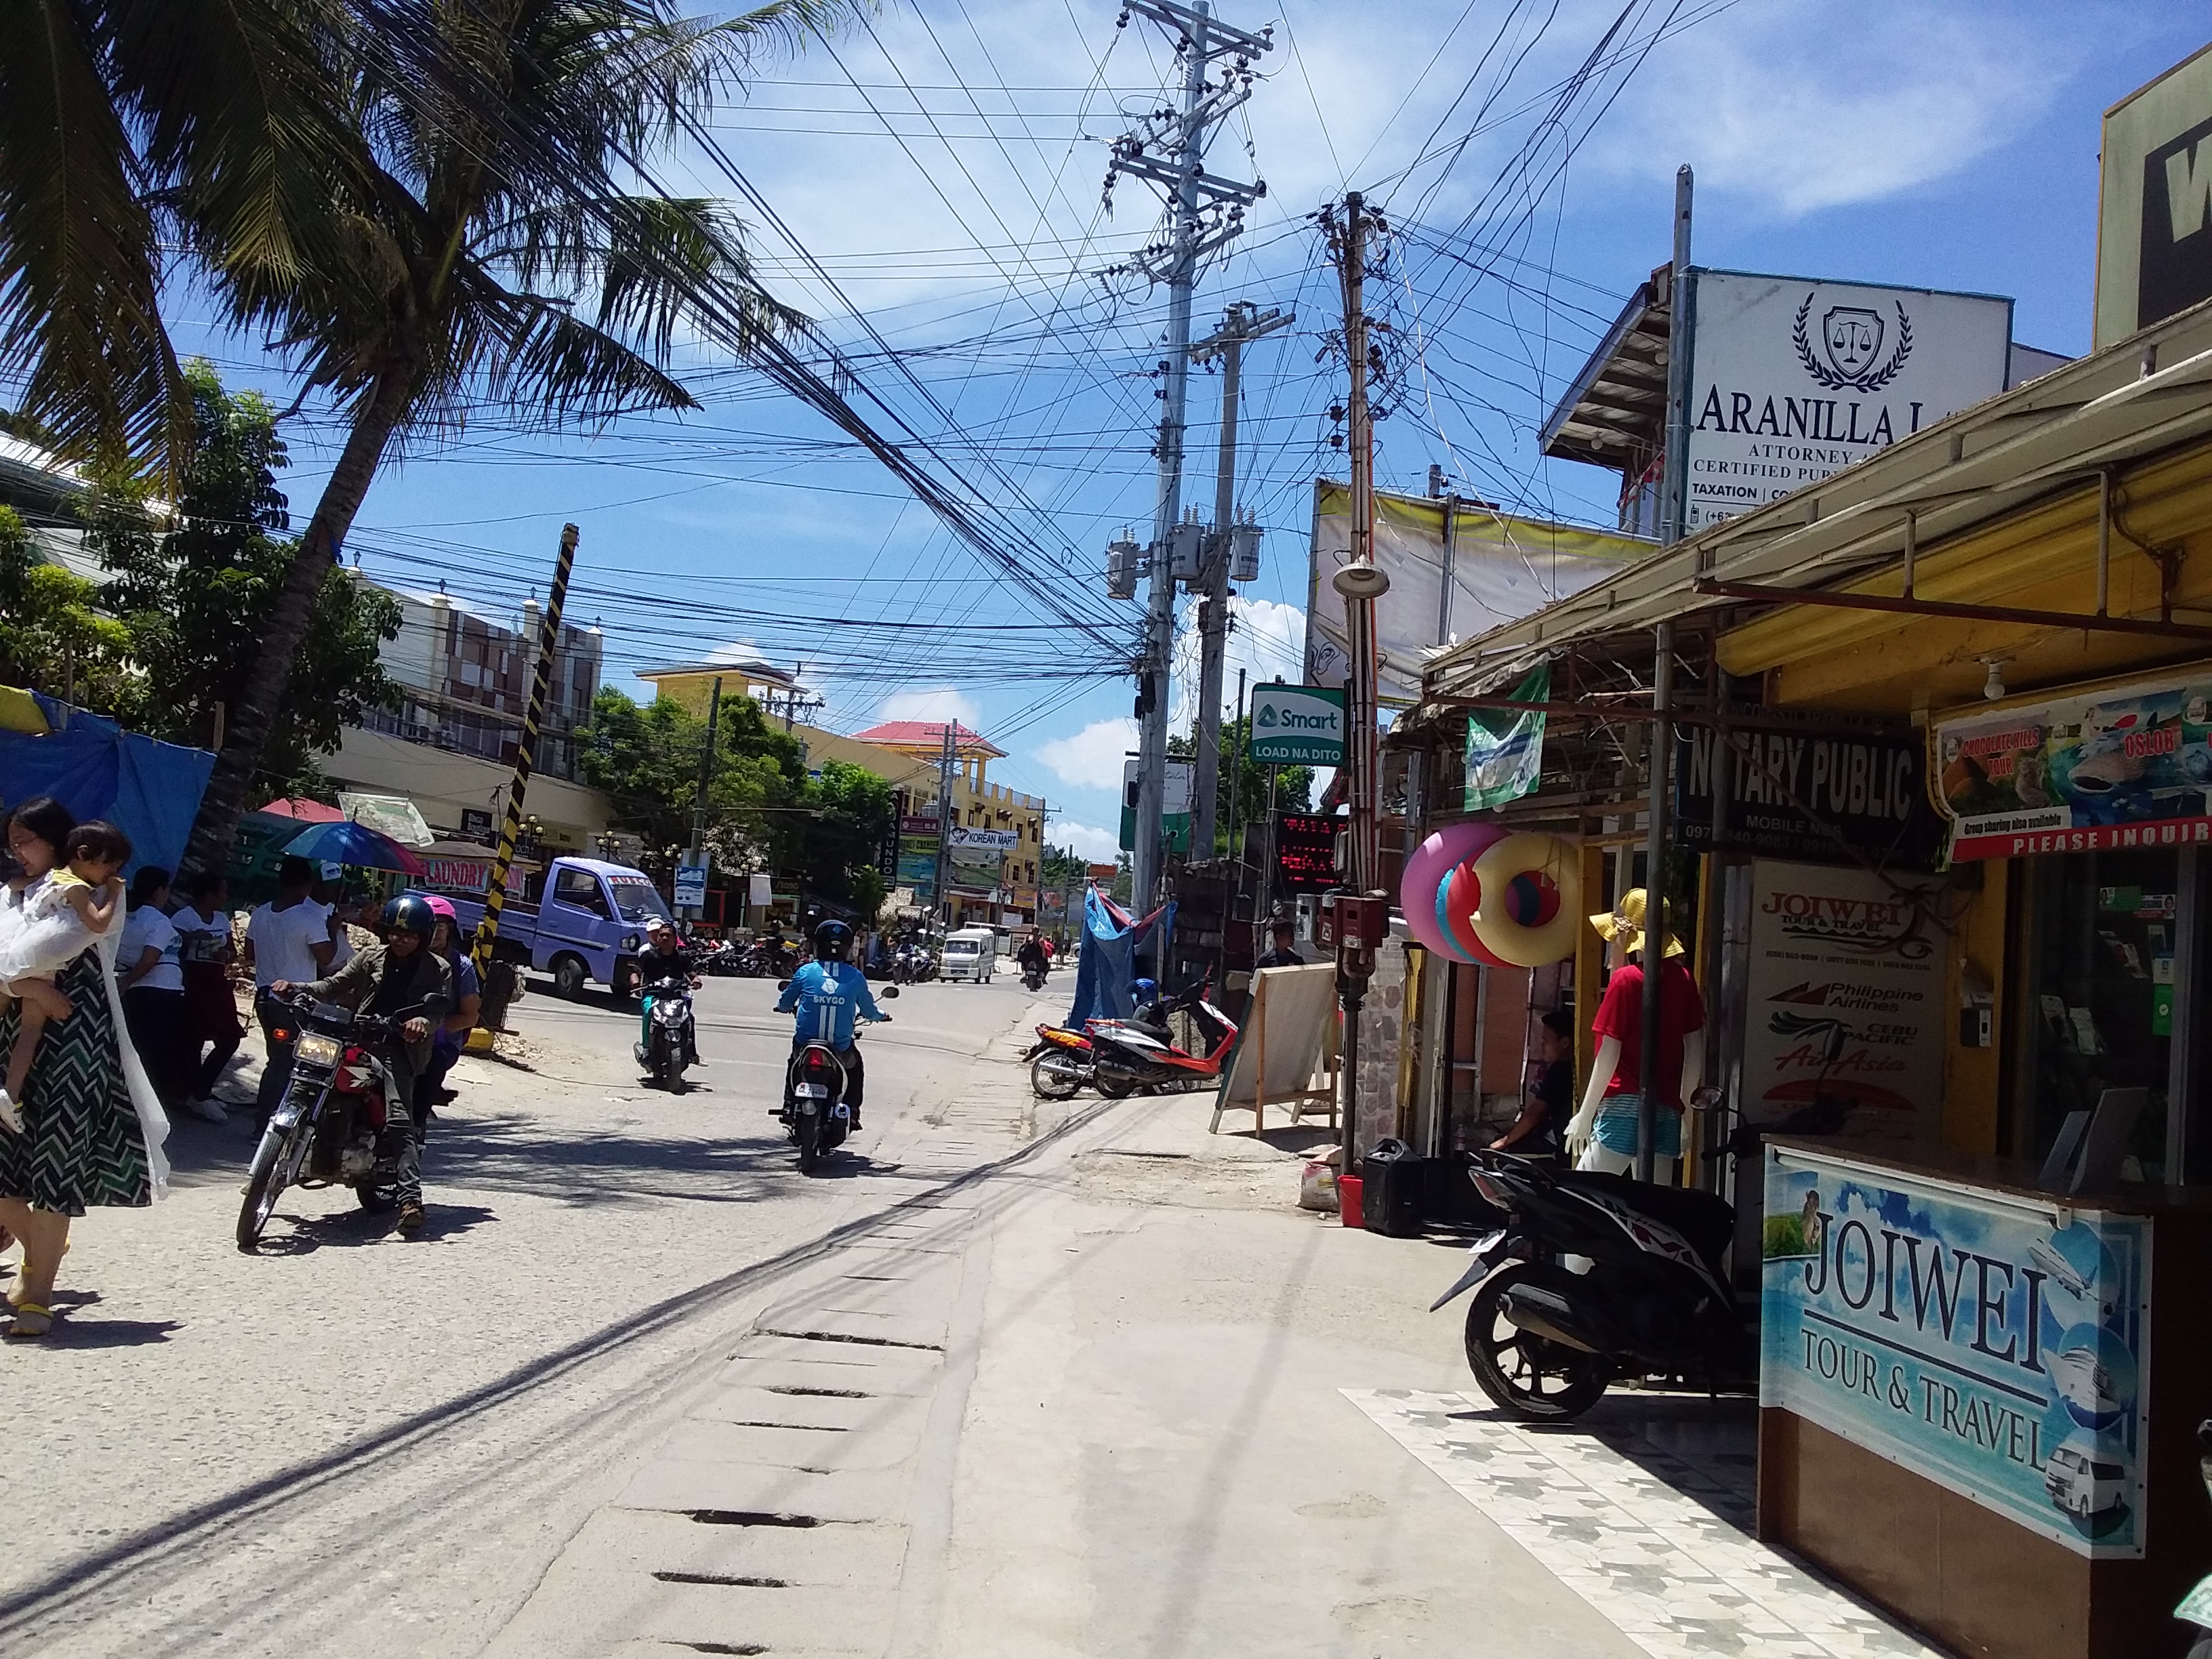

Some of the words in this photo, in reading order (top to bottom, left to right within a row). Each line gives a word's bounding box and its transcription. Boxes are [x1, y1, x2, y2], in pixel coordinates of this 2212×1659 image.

[1696, 383, 1894, 445] ARANILLA
[1748, 444, 1855, 464] ATTORNEY
[1693, 459, 1791, 479] CERTIFIED
[1692, 483, 1757, 499] TAXATION
[1280, 710, 1338, 731] Smart
[1963, 734, 2013, 758] CHOCOLATE
[2013, 729, 2041, 750] HILLS
[2124, 728, 2175, 758] OSLOB
[1255, 745, 1289, 759] LOAD
[1292, 747, 1309, 760] NA
[1311, 747, 1342, 762] DITO
[1988, 758, 2014, 777] TOUR
[1811, 740, 1913, 821] PUBLIC
[1746, 815, 1805, 834] MOBILE
[1964, 823, 1984, 836] Group
[1984, 818, 2011, 833] sharing
[2011, 817, 2028, 830] also
[2028, 814, 2062, 829] available
[968, 832, 996, 844] KOREAN
[998, 835, 1017, 846] MART
[2013, 832, 2098, 855] PLEASE
[426, 861, 485, 887] LAUNDRY
[1761, 892, 1902, 926] JOIWEI
[1781, 915, 1815, 926] TOUR
[1818, 918, 1828, 927] &
[1832, 920, 1883, 932] TRAVEL
[813, 995, 845, 1005] SKYGO
[1829, 983, 1924, 1001] Philippine
[1828, 996, 1900, 1012] Airlines
[1843, 1031, 1915, 1046] PACIFIC
[1867, 1023, 1919, 1036] CEBU
[1804, 1211, 2049, 1374] JOIWEI
[1801, 1328, 1881, 1401] TOUR
[1888, 1366, 1913, 1414] &
[1919, 1375, 2049, 1473] TRAVEL
